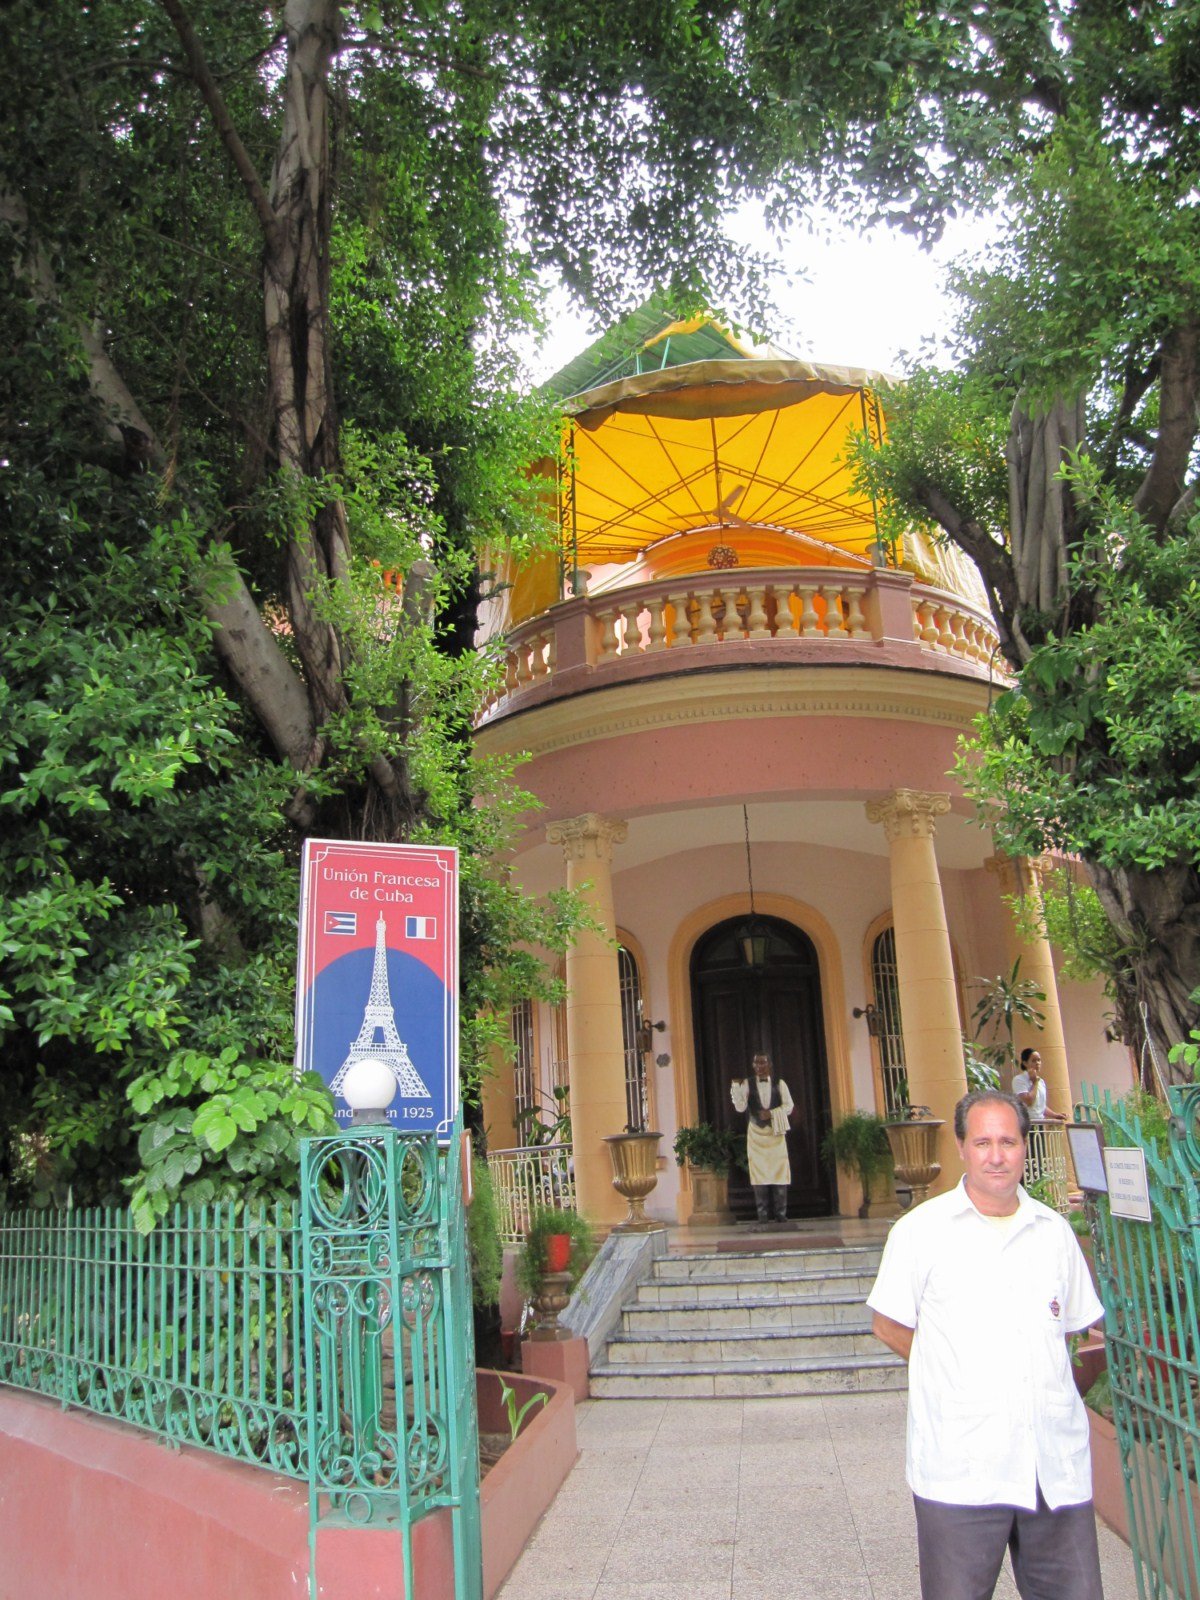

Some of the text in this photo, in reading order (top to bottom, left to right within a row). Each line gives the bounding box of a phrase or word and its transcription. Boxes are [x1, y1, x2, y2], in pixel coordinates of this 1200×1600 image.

[323, 867, 440, 887] Unión Francesa
[350, 886, 414, 903] de Cuba
[403, 1107, 434, 1119] 1925
